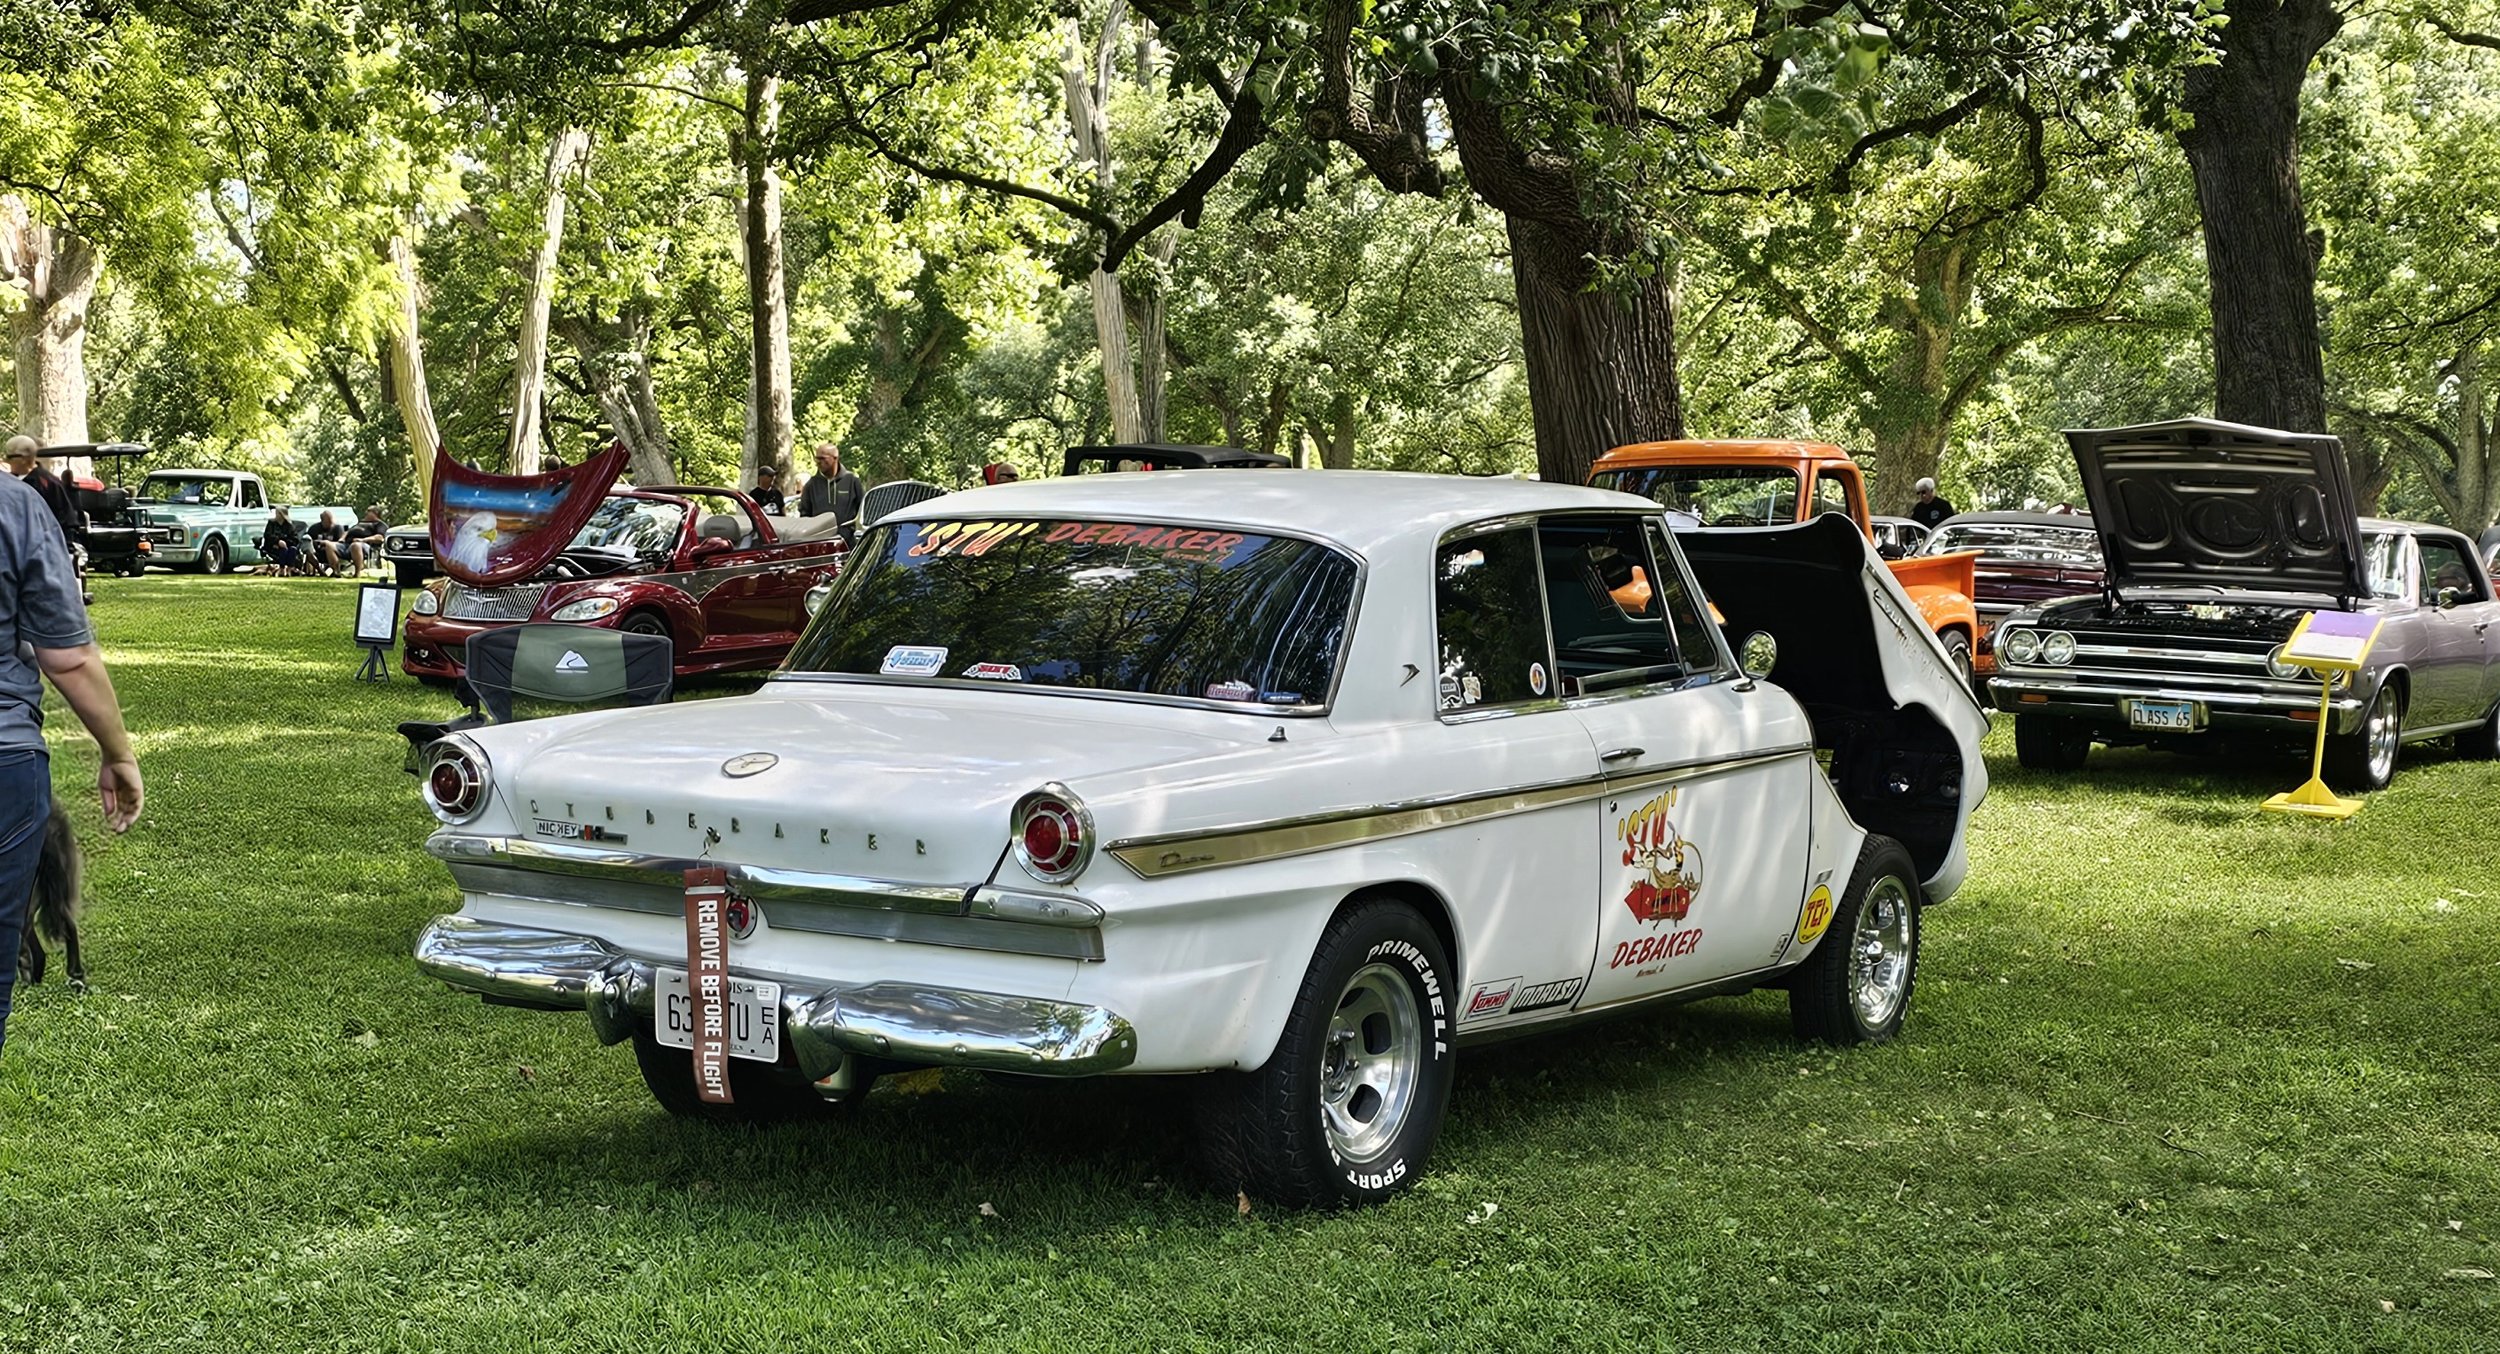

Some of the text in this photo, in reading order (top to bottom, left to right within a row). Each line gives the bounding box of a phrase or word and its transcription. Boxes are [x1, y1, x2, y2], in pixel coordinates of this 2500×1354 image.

[1045, 522, 1244, 553] DEBAKER
[2133, 709, 2190, 727] CLASS 65
[538, 822, 577, 835] NICKEY
[1610, 928, 1703, 970] DEBAKER
[698, 899, 725, 1099] REMOVE BEFORE FLIGHT
[1365, 939, 1448, 1061] PRIMEWELL
[1346, 1157, 1407, 1190] SPORT
